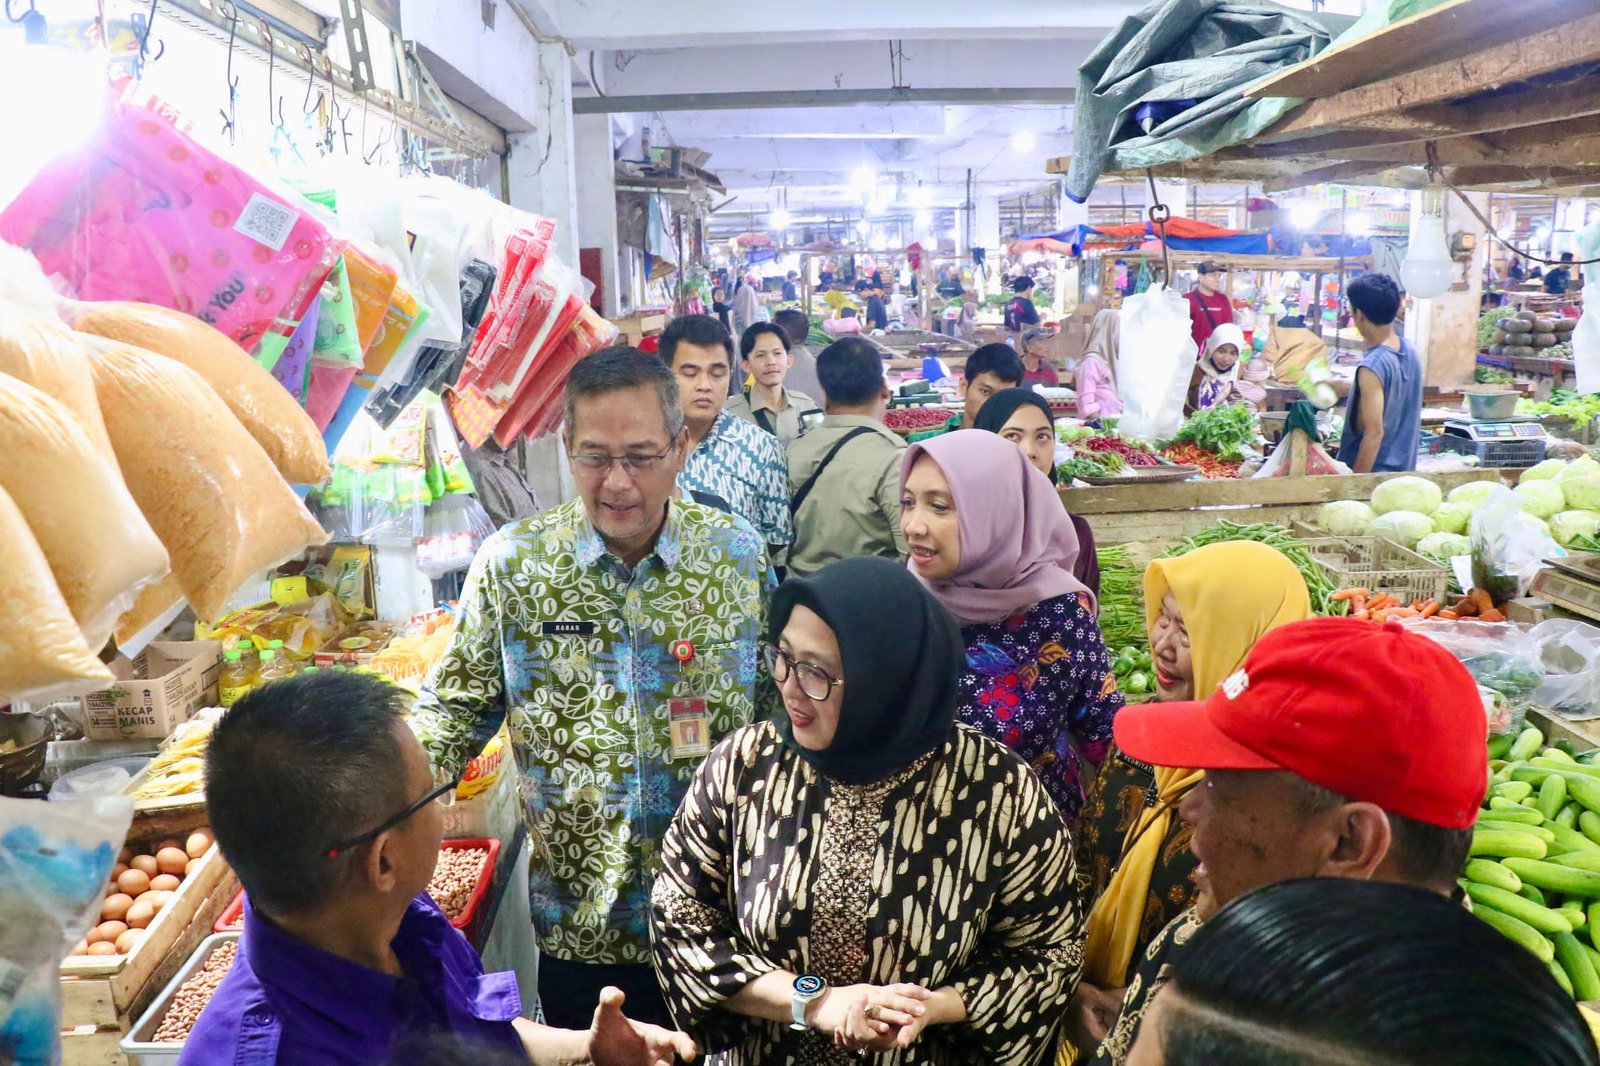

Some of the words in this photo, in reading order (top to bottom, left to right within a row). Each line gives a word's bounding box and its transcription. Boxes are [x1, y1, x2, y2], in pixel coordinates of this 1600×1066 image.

[208, 278, 245, 311] YOU
[117, 707, 153, 716] KECAP
[119, 717, 155, 725] MANIS
